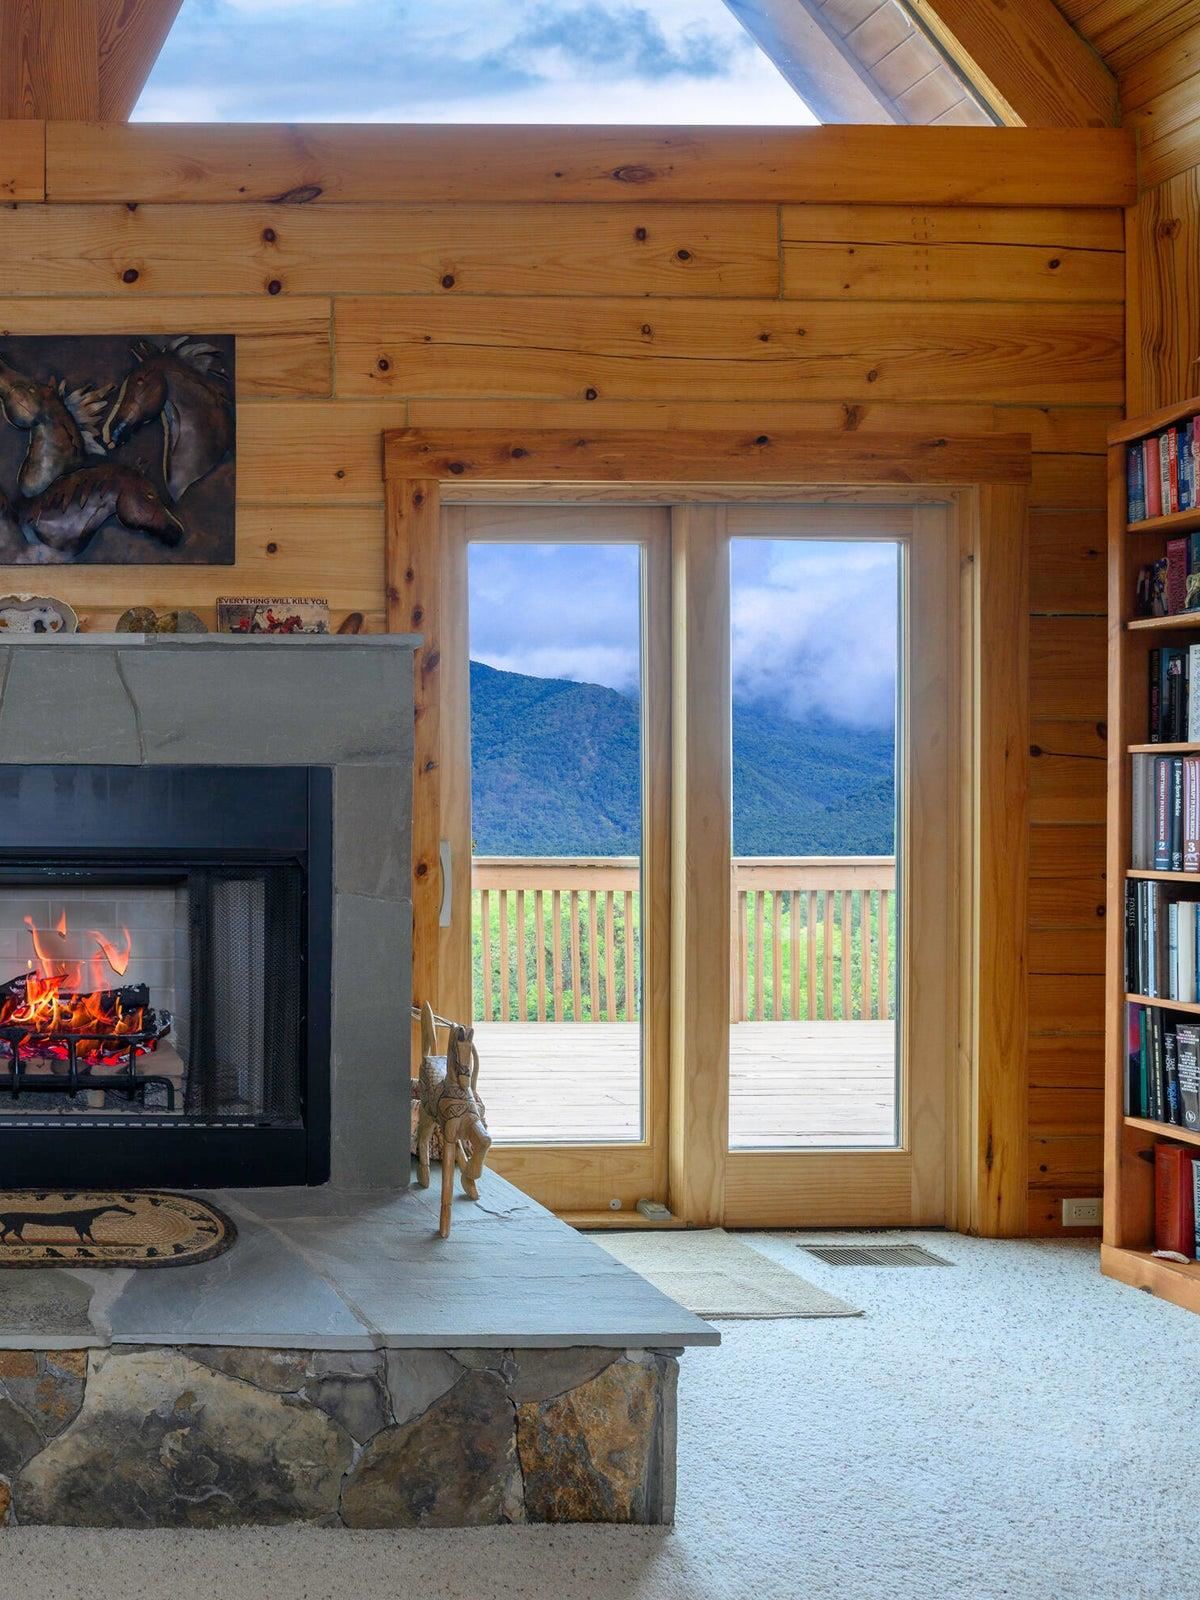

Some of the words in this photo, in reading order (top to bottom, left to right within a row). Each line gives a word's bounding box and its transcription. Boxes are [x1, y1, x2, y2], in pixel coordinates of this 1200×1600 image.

[1158, 841, 1166, 850] 2
[1187, 842, 1196, 853] 3
[1128, 898, 1136, 927] FOSSILS
